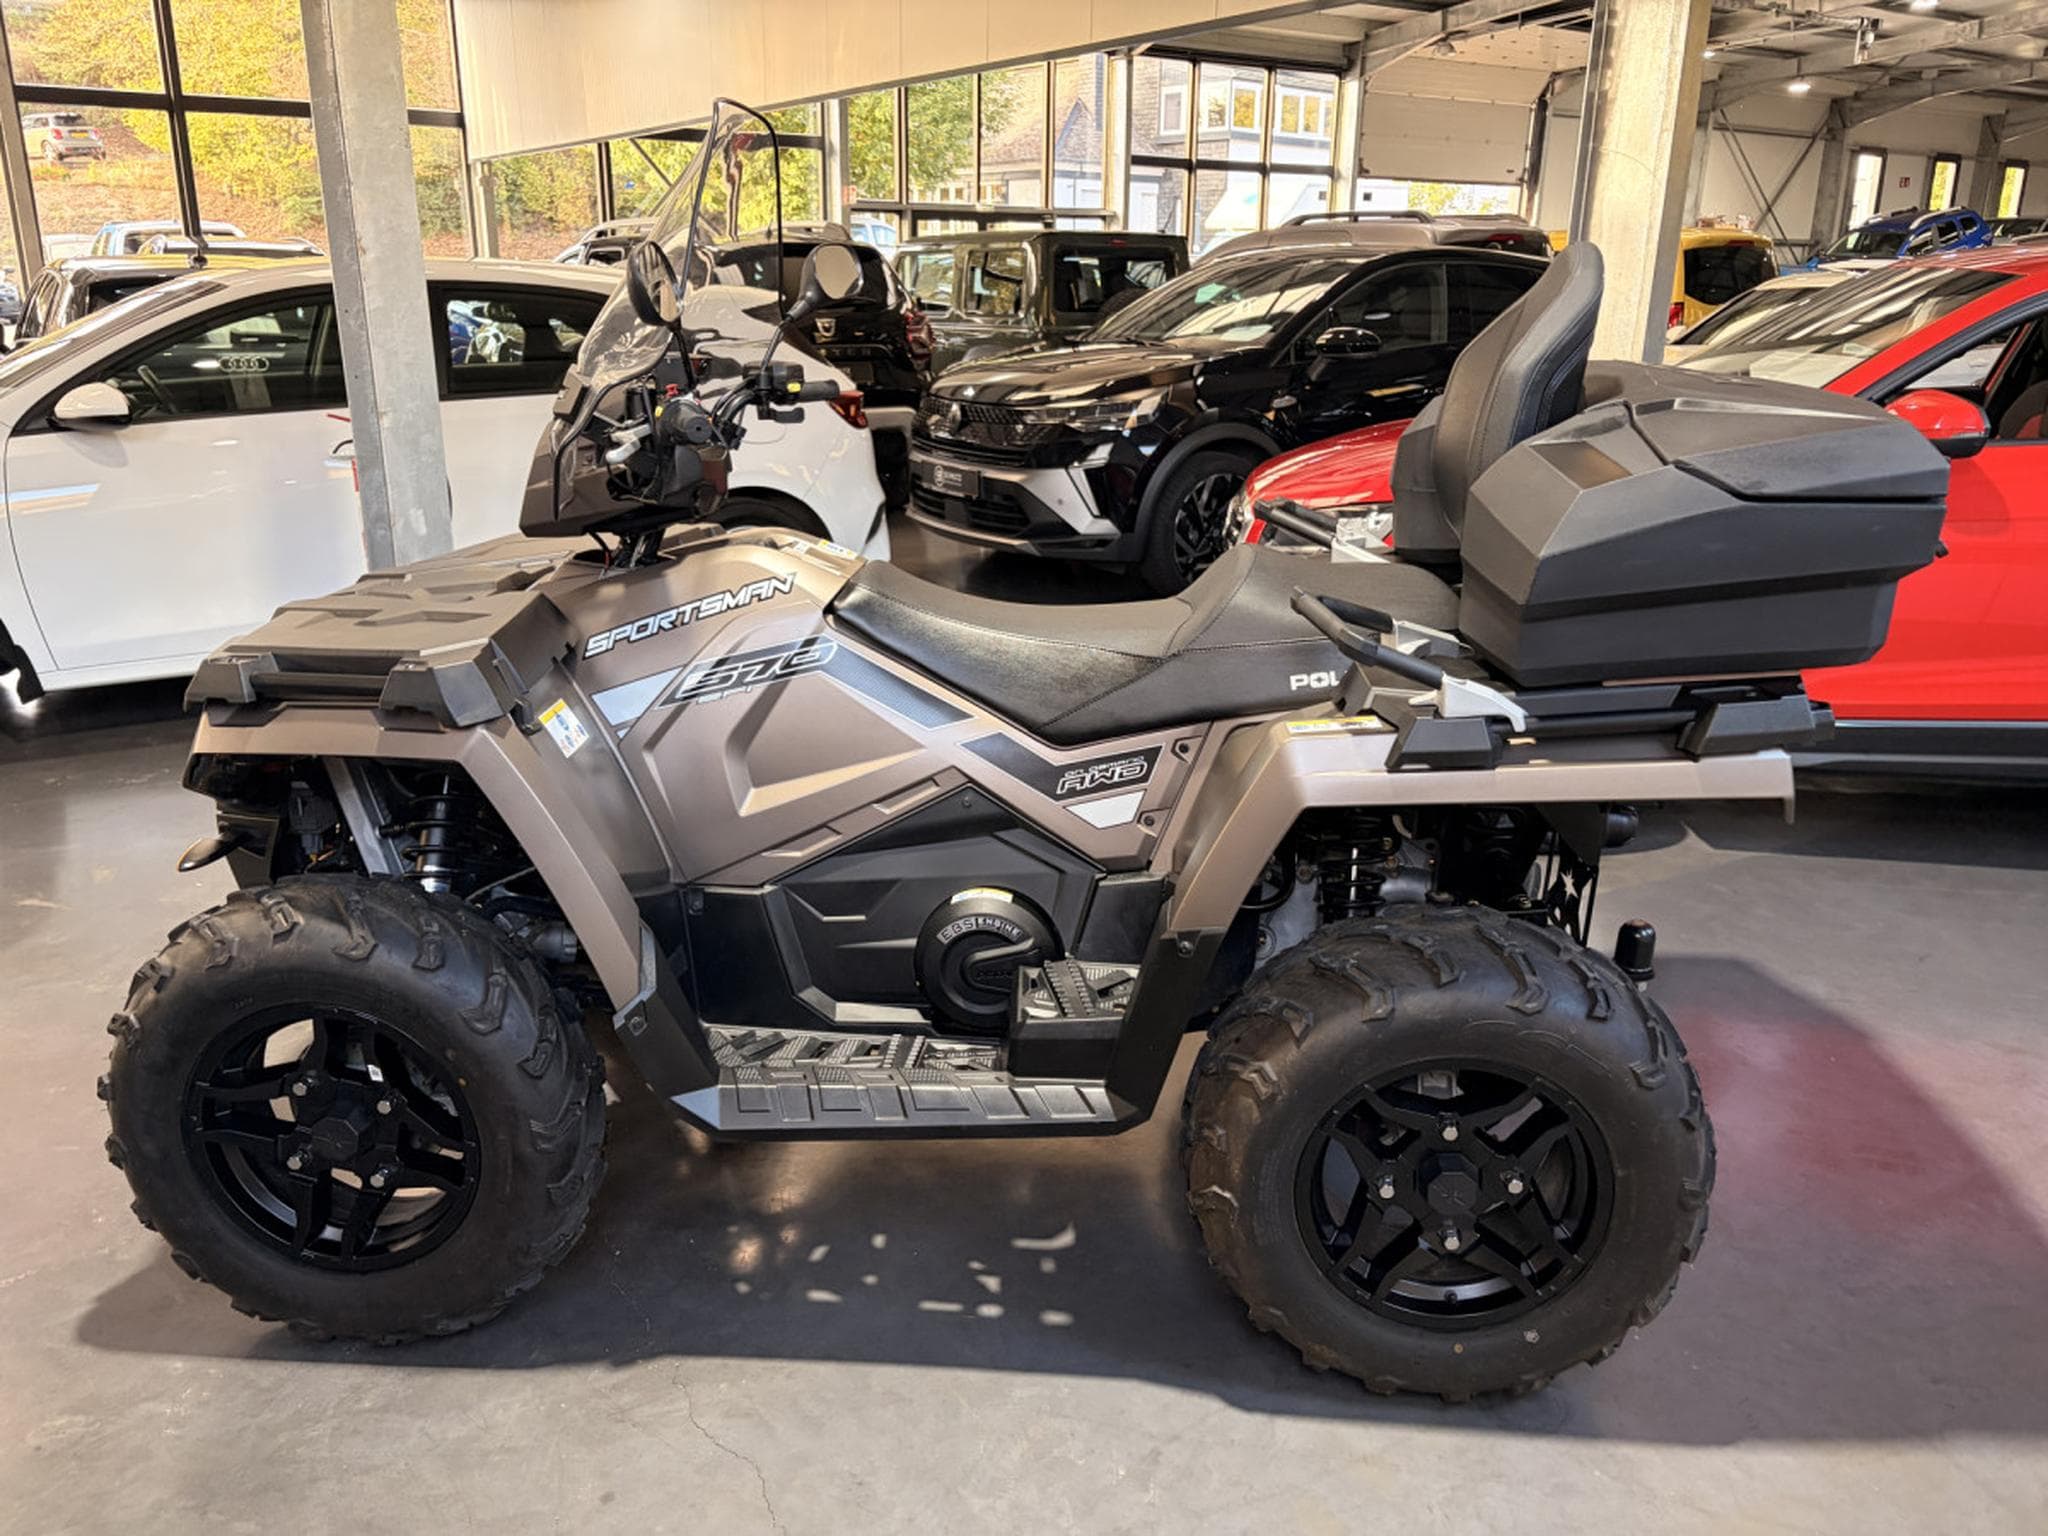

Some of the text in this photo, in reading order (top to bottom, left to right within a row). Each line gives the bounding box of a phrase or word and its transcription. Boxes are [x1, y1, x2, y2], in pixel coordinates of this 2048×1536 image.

[583, 572, 796, 660] SPORTSMAN
[1290, 670, 1341, 691] POL
[1056, 761, 1148, 794] AWD
[940, 919, 974, 942] EBS
